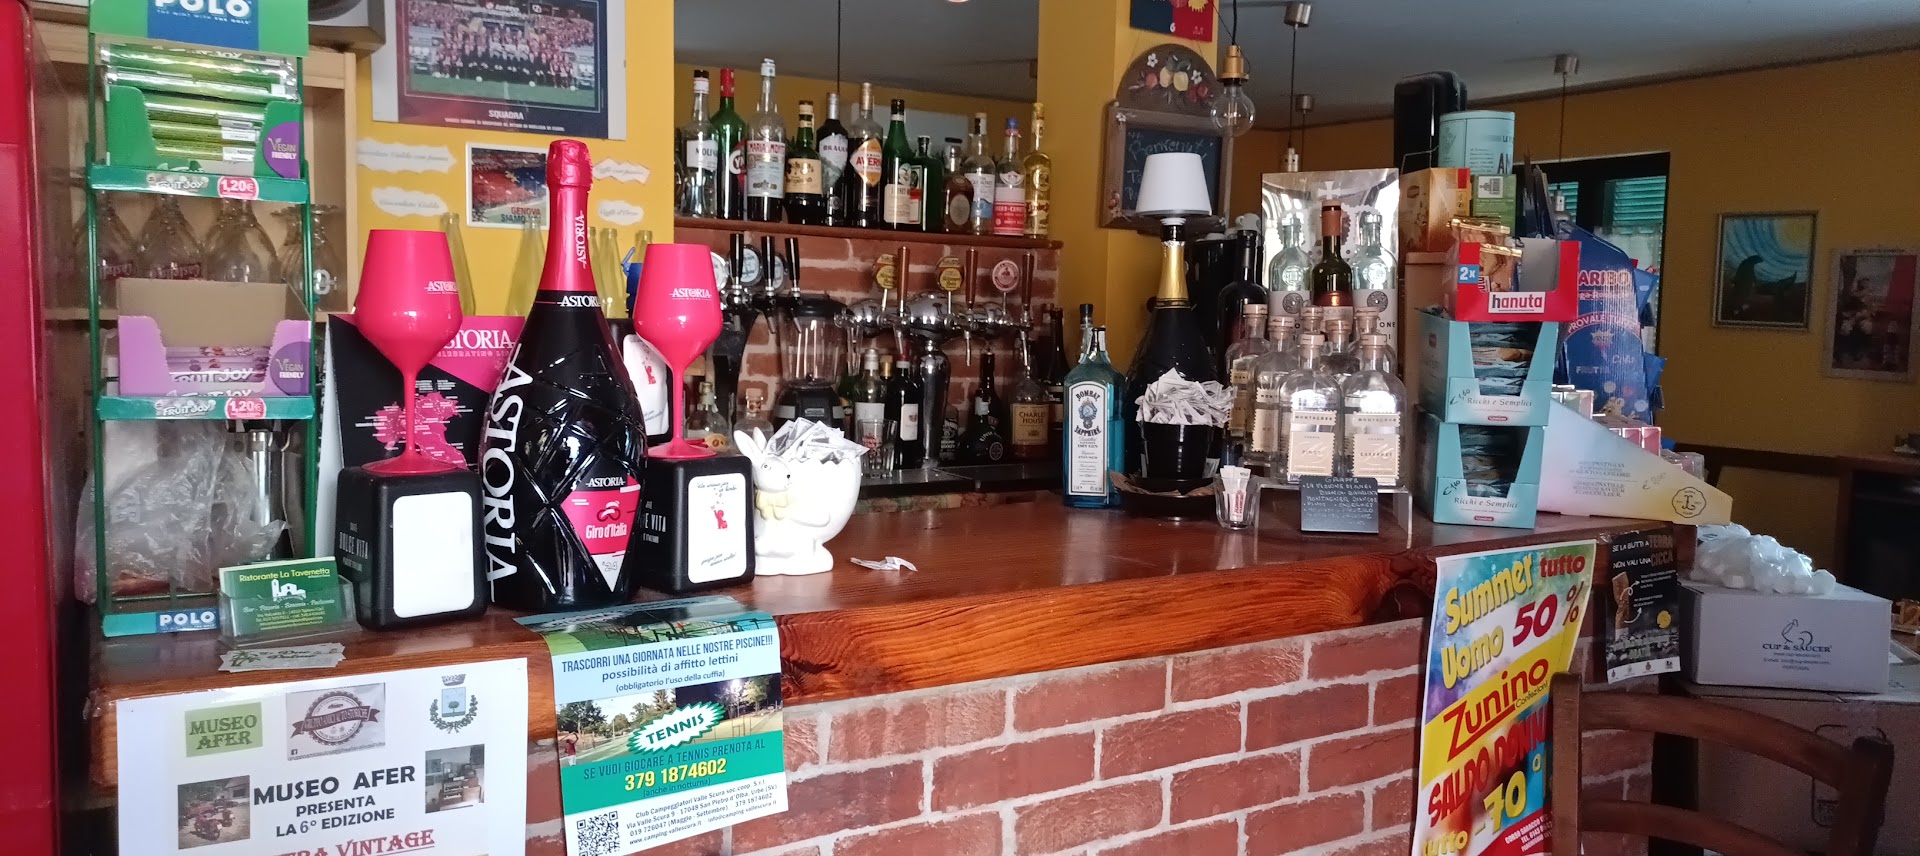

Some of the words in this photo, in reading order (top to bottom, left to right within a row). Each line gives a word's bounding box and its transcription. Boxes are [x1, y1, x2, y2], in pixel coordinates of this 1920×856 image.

[488, 109, 525, 120] SQUADRA
[268, 136, 296, 152] VEGAN
[271, 150, 297, 160] FRIENDLY
[155, 181, 185, 191] FRUIT
[184, 180, 205, 189] JOY
[220, 179, 254, 193] 1,20€
[500, 213, 526, 224] SIAMO
[511, 206, 541, 215] GENOVA
[574, 210, 587, 269] ASTORIA
[1459, 266, 1476, 281] 2x
[1578, 270, 1631, 287] ARIBO
[669, 288, 712, 299] ASTORIA
[1491, 293, 1543, 309] hanuta
[443, 329, 516, 350] STORIA
[275, 358, 304, 371] VEGAN
[219, 367, 254, 382] JOY
[279, 371, 305, 379] FRIENDLY
[1075, 389, 1101, 402] BOMBAY
[1467, 397, 1491, 405] Ricchi
[1499, 399, 1533, 408] Semplici
[163, 404, 191, 416] FRUIT
[191, 403, 212, 413] JOY
[229, 400, 263, 413] 1,20€
[1074, 425, 1102, 437] SAPPHIRE
[482, 343, 534, 602] ASTORIA
[585, 476, 626, 488] ASTORIA
[1454, 497, 1477, 505] Ricchi
[1486, 499, 1519, 509] Semplici
[586, 525, 604, 539] Giro
[604, 522, 628, 538] d'Italia
[651, 513, 667, 533] VITA
[1612, 545, 1620, 553] SE
[1612, 561, 1626, 569] NON
[1626, 559, 1639, 567] VALI
[1638, 557, 1651, 565] UNA
[239, 572, 279, 582] Ristorante
[279, 570, 290, 579] La
[290, 568, 330, 577] Tavernetta
[1445, 552, 1535, 635] Summer
[1539, 554, 1586, 579] tutto
[159, 611, 215, 627] POLO
[1440, 624, 1505, 689] Uomo
[1512, 593, 1558, 648] 50
[1562, 580, 1584, 627] %
[561, 657, 611, 673] TRASCORRI
[612, 655, 631, 666] UNA
[632, 647, 675, 663] GIORNATA
[676, 644, 701, 657] NELLE
[703, 640, 734, 655] NOSTRE
[735, 634, 774, 650] PISCINE!!!
[1792, 644, 1831, 653] SAUCER
[602, 664, 658, 683] possibilità
[660, 660, 671, 672] di
[674, 657, 706, 671] affitto
[708, 653, 739, 666] lettini
[615, 678, 664, 693] (obbligatorio
[665, 676, 682, 687] l'uso
[684, 672, 702, 683] della
[702, 669, 726, 681] cuffia)
[1515, 679, 1549, 709] Confezioni
[1442, 657, 1549, 764] Zunino
[189, 713, 258, 737] MUSEO
[645, 712, 706, 746] TENNIS
[196, 731, 252, 751] AFER
[583, 768, 596, 780] SE
[598, 763, 621, 777] VUOI
[624, 755, 665, 772] GIOCARE
[667, 755, 674, 764] A
[677, 747, 710, 763] TENNIS
[712, 742, 752, 757] PRENOTA
[754, 738, 766, 750] AL
[624, 771, 656, 791] 379
[660, 757, 727, 785] 1874602
[253, 776, 340, 806] MUSEO
[353, 765, 416, 791] AFER
[642, 786, 667, 799] (anche
[668, 784, 676, 794] in
[677, 777, 712, 792] notturna)
[1427, 746, 1491, 829] SALDO
[296, 794, 376, 817] PRESENTA
[635, 809, 650, 819] Club
[650, 798, 693, 816] Campeggiatori
[692, 794, 708, 805] Valle
[708, 789, 726, 801] Scura
[626, 821, 637, 830] Via
[637, 816, 652, 827] Valle
[653, 812, 670, 823] Scura
[699, 800, 711, 810] San
[711, 796, 729, 807] Pietro
[629, 828, 642, 837] 019
[734, 798, 746, 808] 379
[276, 823, 297, 837] LA
[300, 819, 317, 834] 6°
[321, 808, 396, 830] EDIZIONE
[335, 828, 435, 856] VINTAGE
